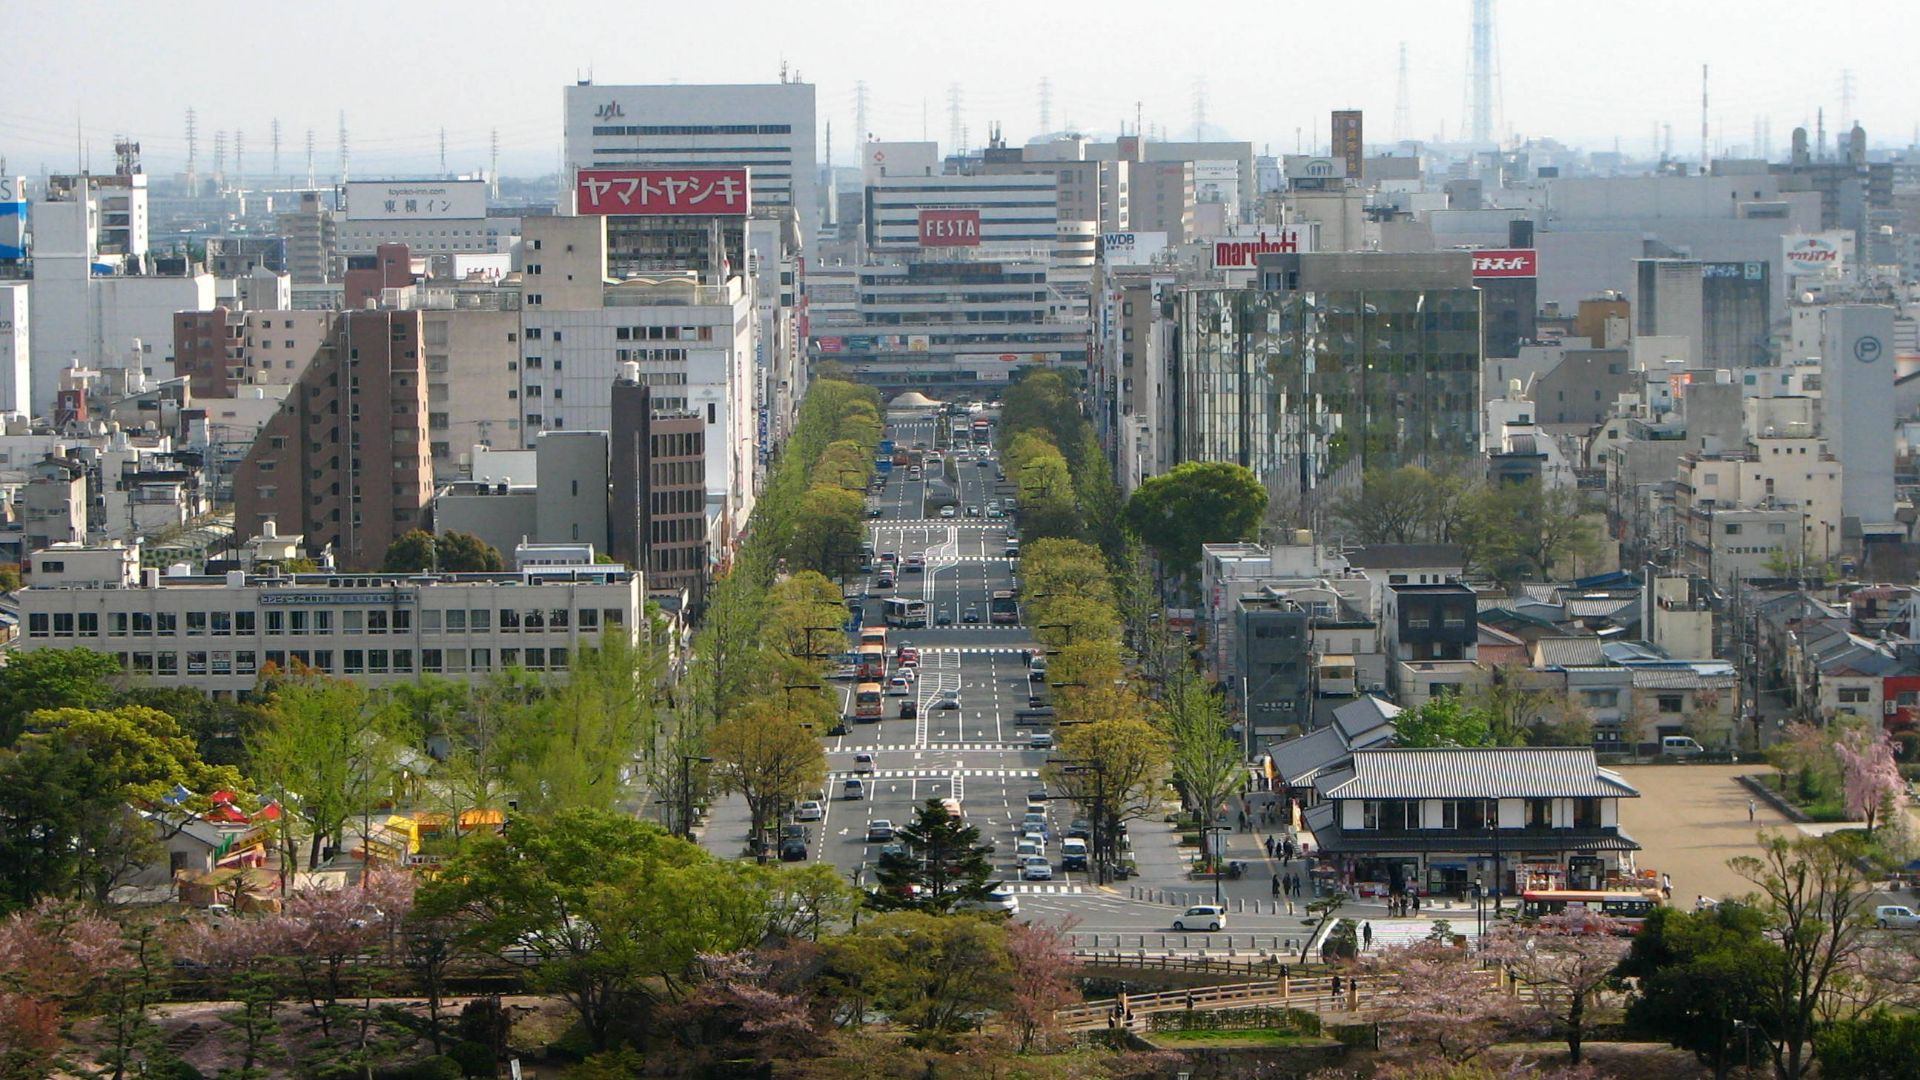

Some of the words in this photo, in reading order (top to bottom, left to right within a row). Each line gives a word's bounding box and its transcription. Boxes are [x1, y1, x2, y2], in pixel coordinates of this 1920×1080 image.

[581, 176, 743, 206] ヤマトヤシキ
[384, 199, 451, 213] 東横イン
[926, 219, 976, 237] FESTA
[1105, 234, 1135, 245] WDB
